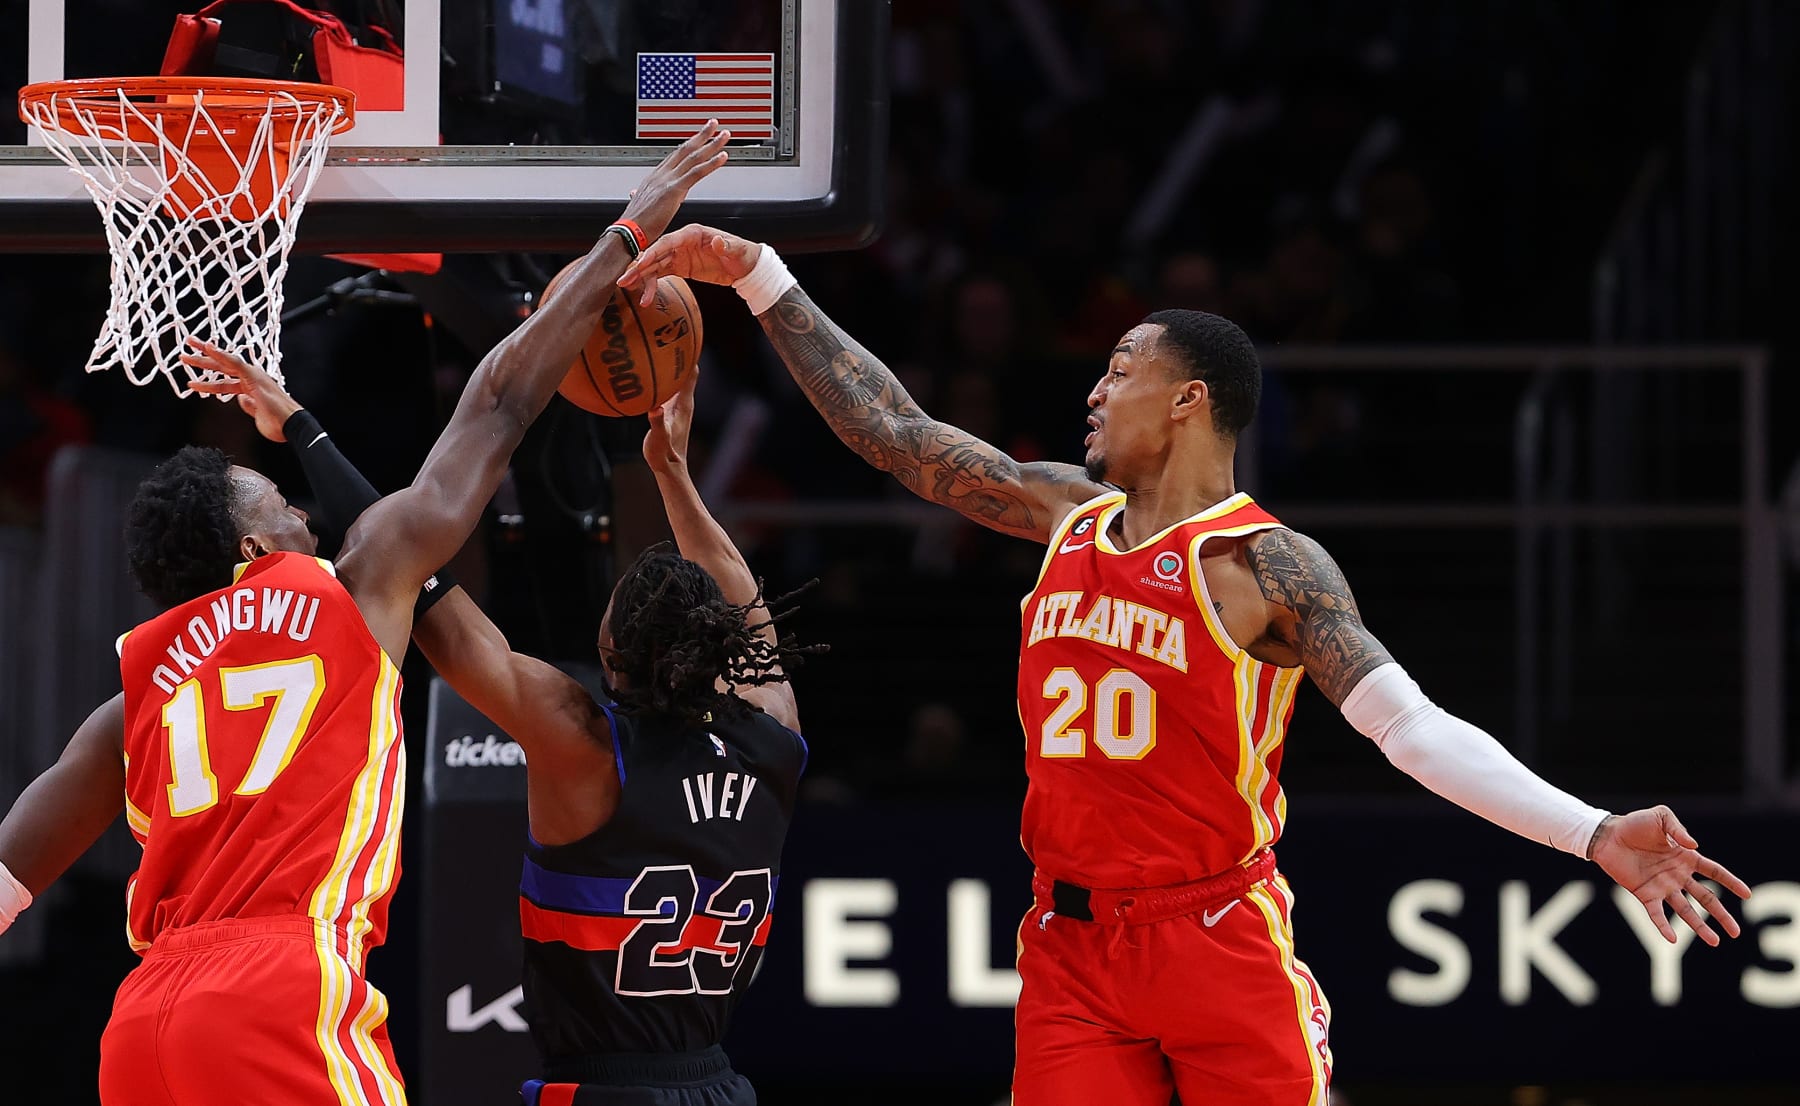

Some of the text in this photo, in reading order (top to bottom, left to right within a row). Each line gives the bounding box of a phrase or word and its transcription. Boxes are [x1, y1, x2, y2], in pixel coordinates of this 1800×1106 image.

[1074, 518, 1094, 534] 6
[1140, 577, 1183, 592] sharecare
[152, 587, 320, 695] OKONGWU
[1027, 591, 1188, 674] ATLANTA
[162, 654, 326, 817] 17
[1040, 667, 1157, 760] 20
[682, 772, 757, 823] IVEY
[615, 865, 772, 995] 23
[803, 878, 1023, 1007] EL
